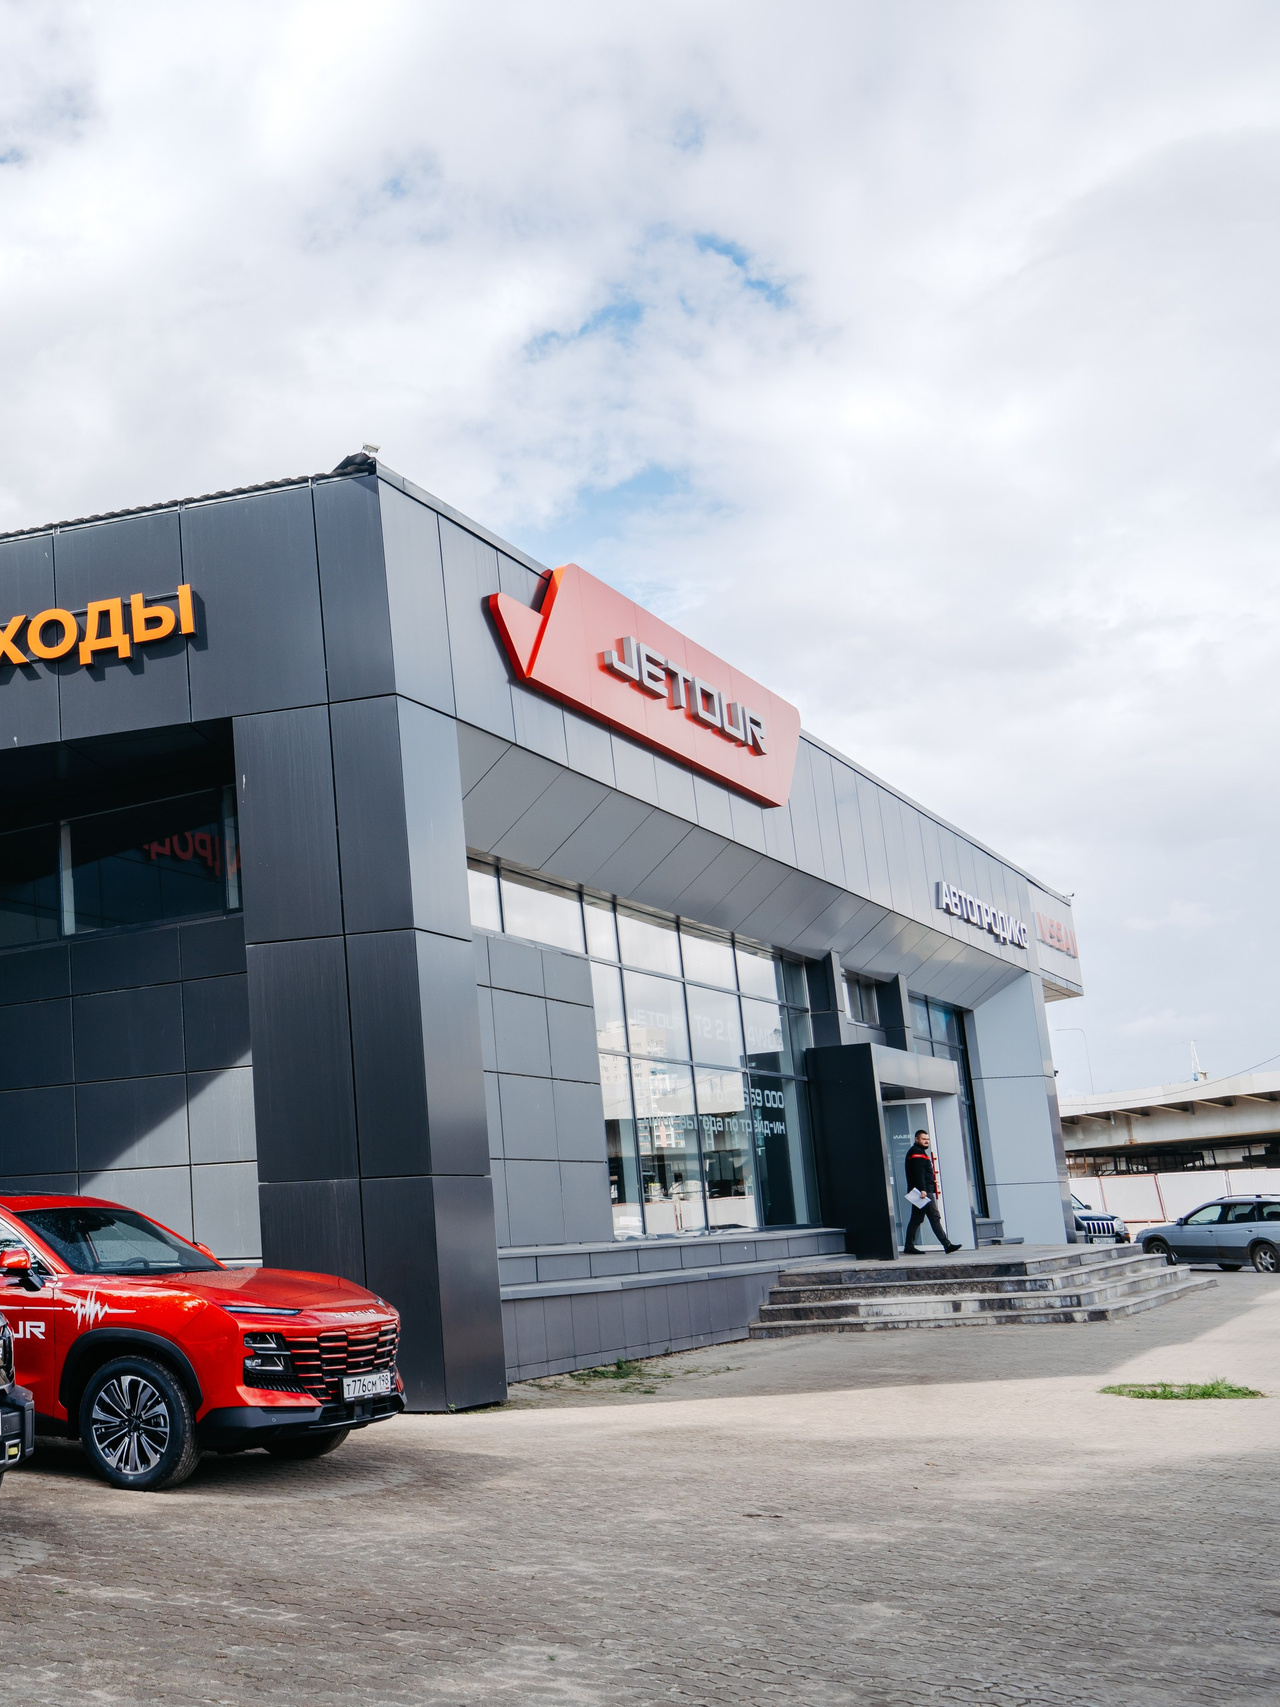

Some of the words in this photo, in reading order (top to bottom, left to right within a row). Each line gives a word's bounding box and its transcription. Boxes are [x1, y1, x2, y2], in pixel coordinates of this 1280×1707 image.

[600, 635, 767, 756] JETOUR
[937, 881, 1029, 949] АВТОПРОДИКС
[764, 1089, 785, 1109] 000
